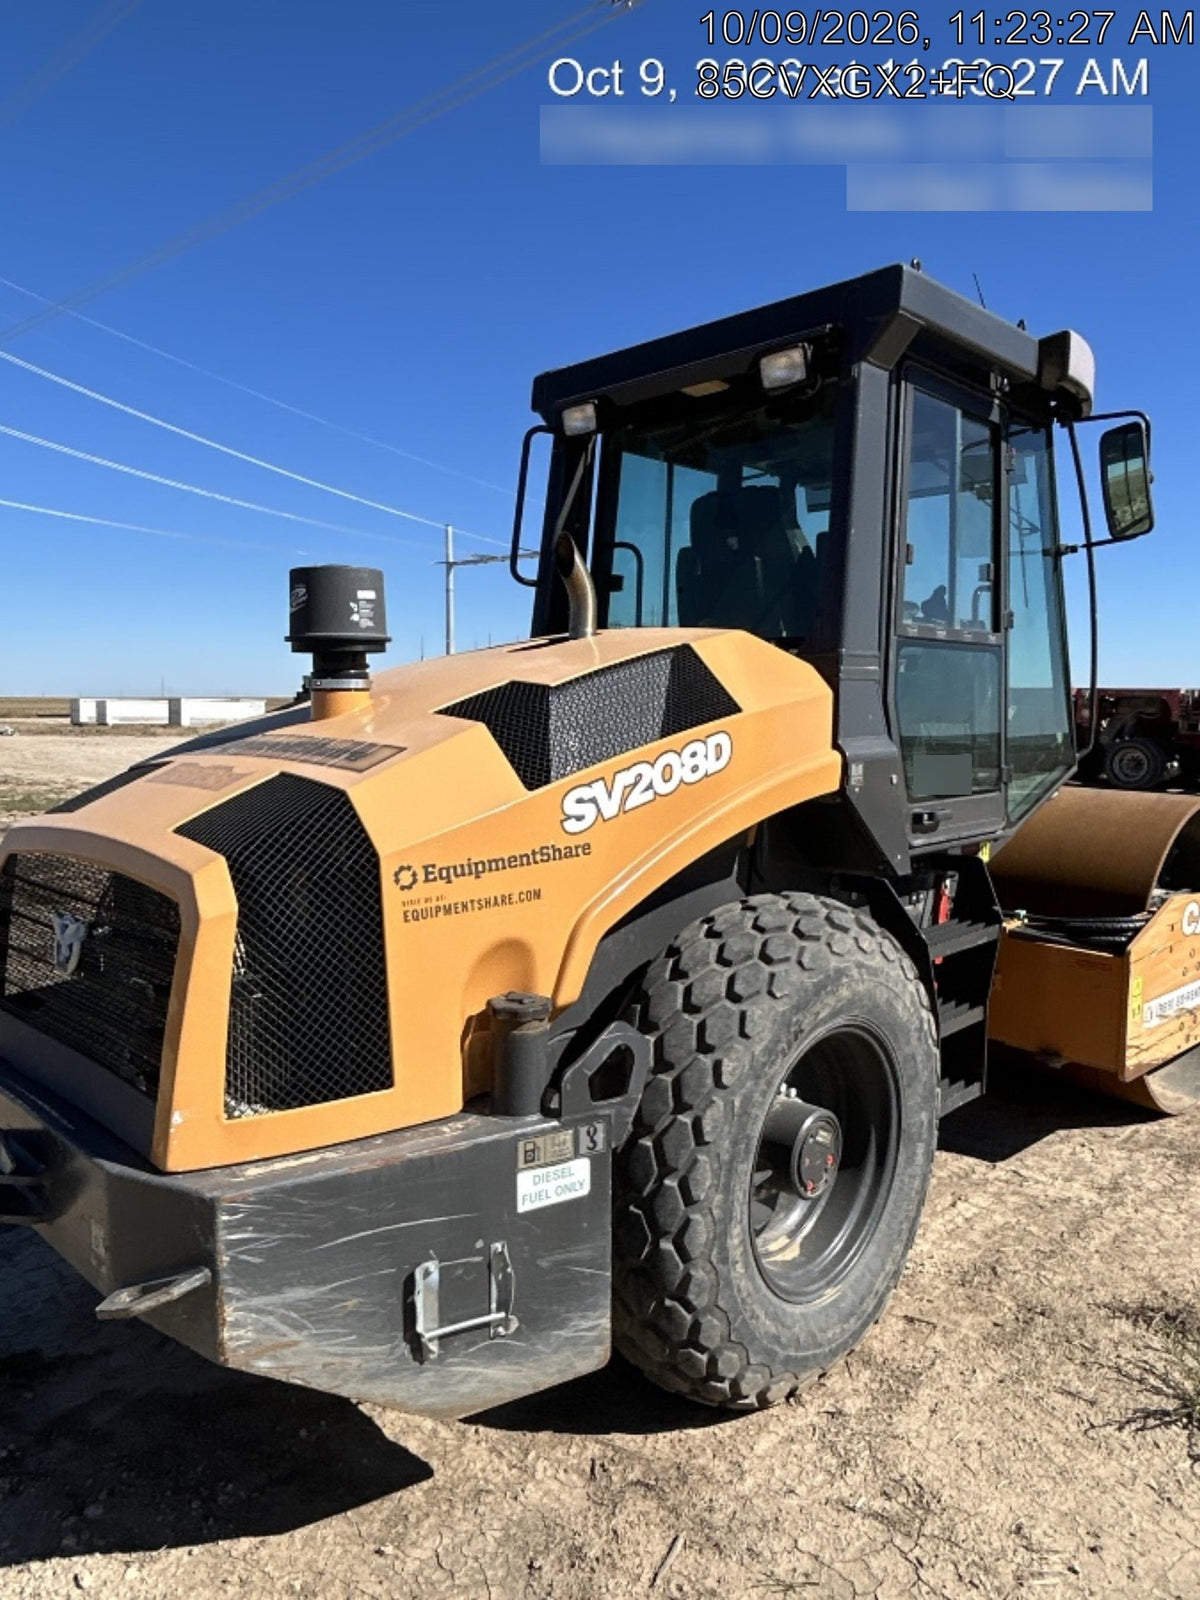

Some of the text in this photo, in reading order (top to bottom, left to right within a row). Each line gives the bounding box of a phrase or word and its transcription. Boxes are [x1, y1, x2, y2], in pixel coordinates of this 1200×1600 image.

[560, 730, 733, 835] SV208D
[422, 842, 592, 884] EquipmentShare
[402, 888, 542, 923] EQUIPMENTSHARE.COM
[522, 1178, 586, 1206] FUEL ONLY
[533, 1166, 575, 1186] DIESEL
